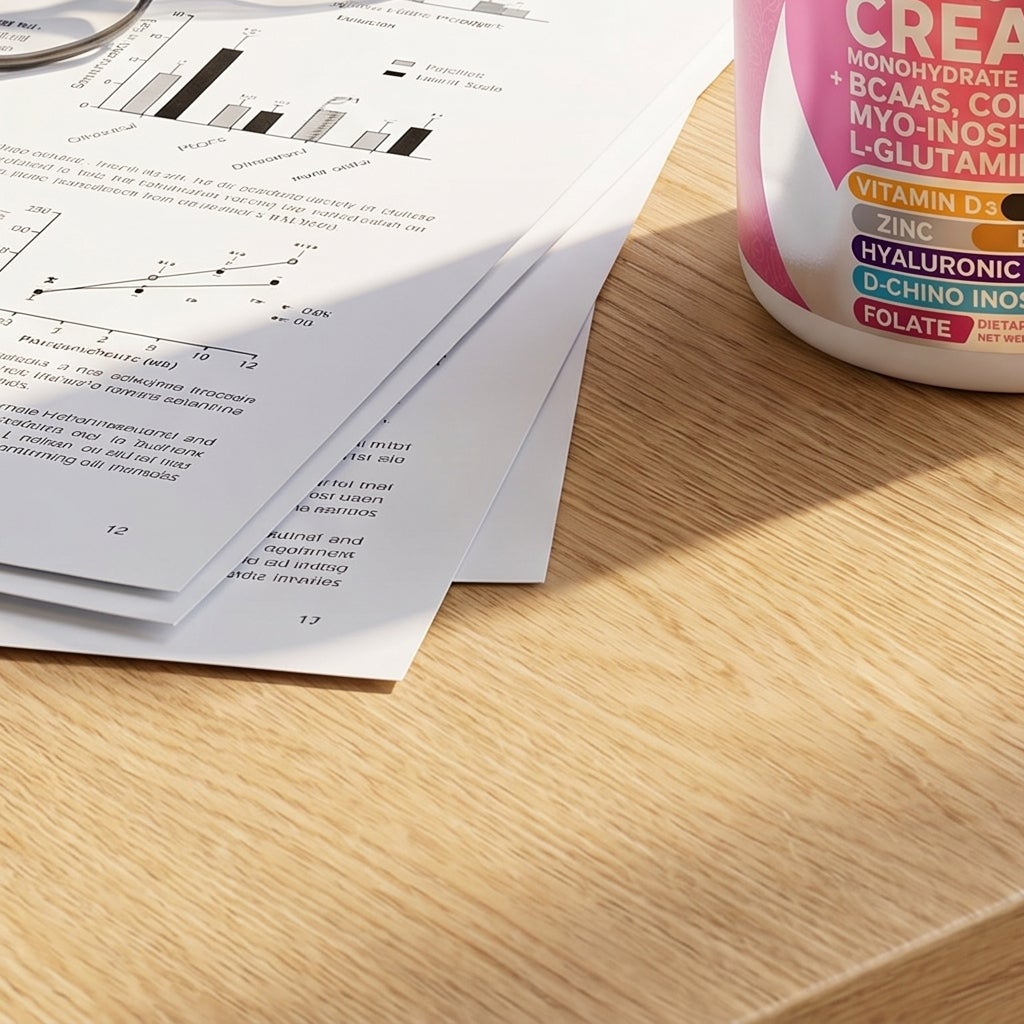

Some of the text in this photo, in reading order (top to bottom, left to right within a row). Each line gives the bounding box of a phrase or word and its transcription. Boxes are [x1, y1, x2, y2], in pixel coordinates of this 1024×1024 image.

[847, 47, 1018, 88] MONOHYDRATE
[849, 71, 959, 118] BCAAS,
[856, 177, 956, 213] VITAMIN
[877, 214, 933, 242] ZINC
[861, 241, 1021, 279] HYALURONIC
[864, 274, 964, 307] D-CHINO
[864, 305, 952, 338] FOLATE
[978, 333, 1000, 343] NET
[239, 360, 258, 370] 12
[105, 525, 129, 536] 12
[328, 536, 365, 546] and
